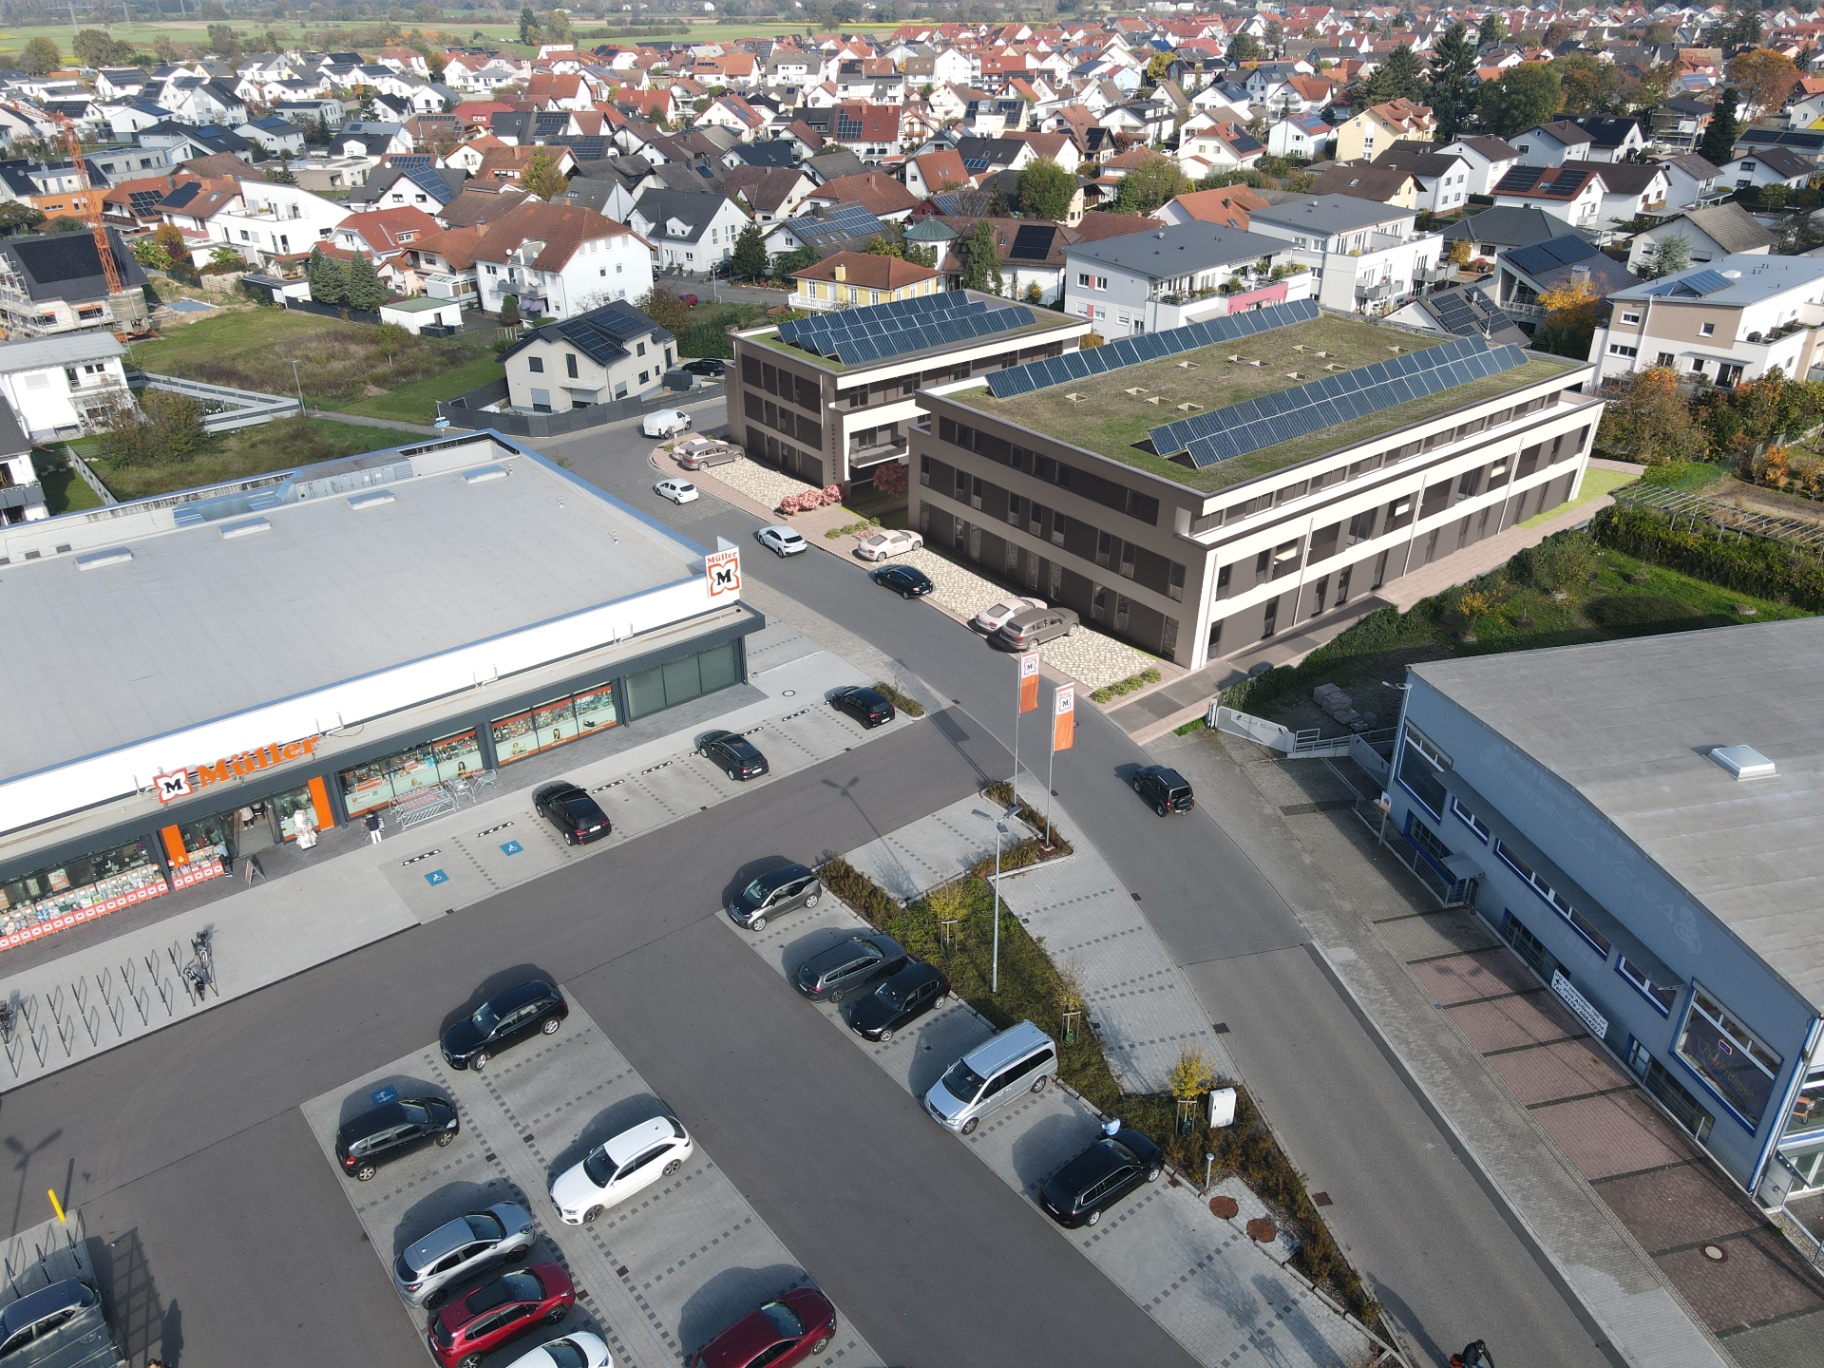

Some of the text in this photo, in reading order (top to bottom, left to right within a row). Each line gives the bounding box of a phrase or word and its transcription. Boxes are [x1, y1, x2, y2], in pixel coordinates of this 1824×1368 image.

[707, 551, 737, 564] Müller
[716, 569, 732, 586] M
[164, 735, 319, 794] M Müller
